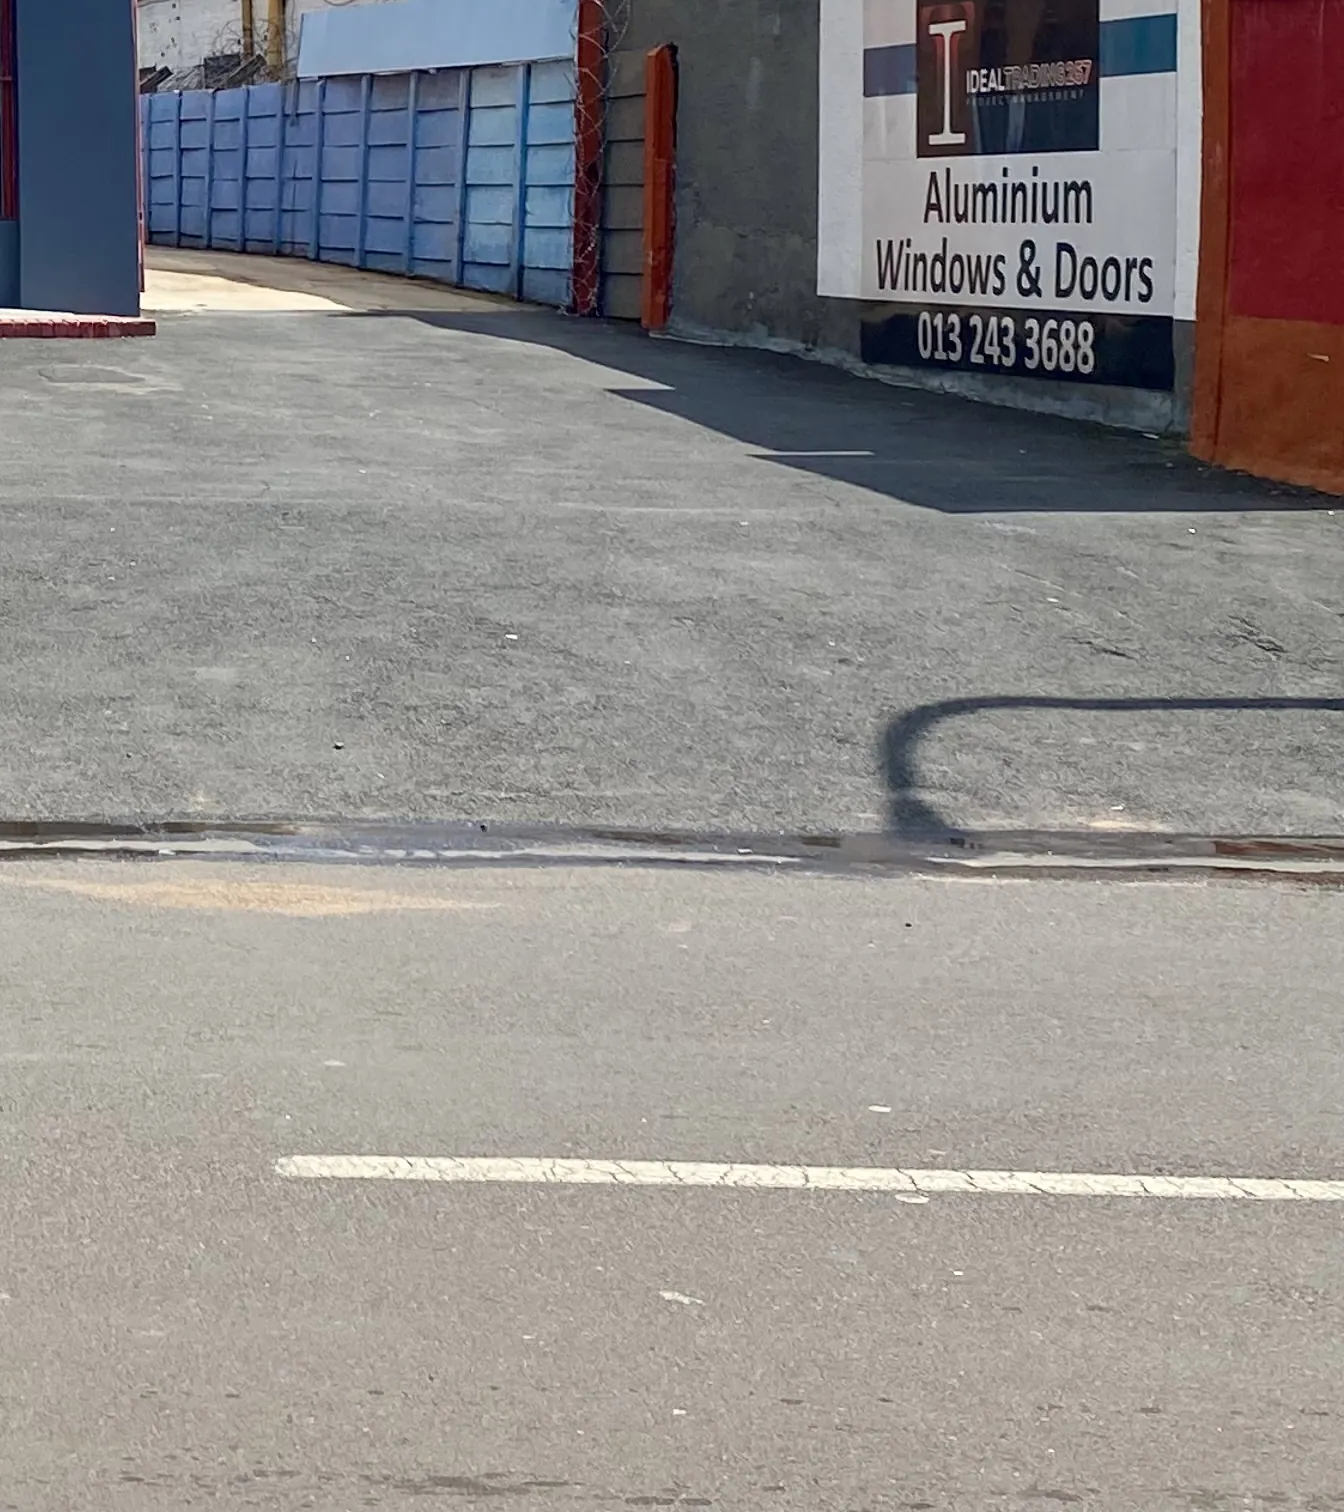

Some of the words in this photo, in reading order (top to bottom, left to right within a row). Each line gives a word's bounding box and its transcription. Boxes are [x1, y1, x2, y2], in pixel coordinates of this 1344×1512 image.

[923, 166, 1093, 224] Aluminium
[876, 237, 1006, 296] Windows
[1016, 239, 1043, 298] &
[1055, 242, 1154, 303] Doors
[918, 311, 962, 362] 013
[969, 315, 1017, 367] 243
[1024, 318, 1095, 374] 3688
